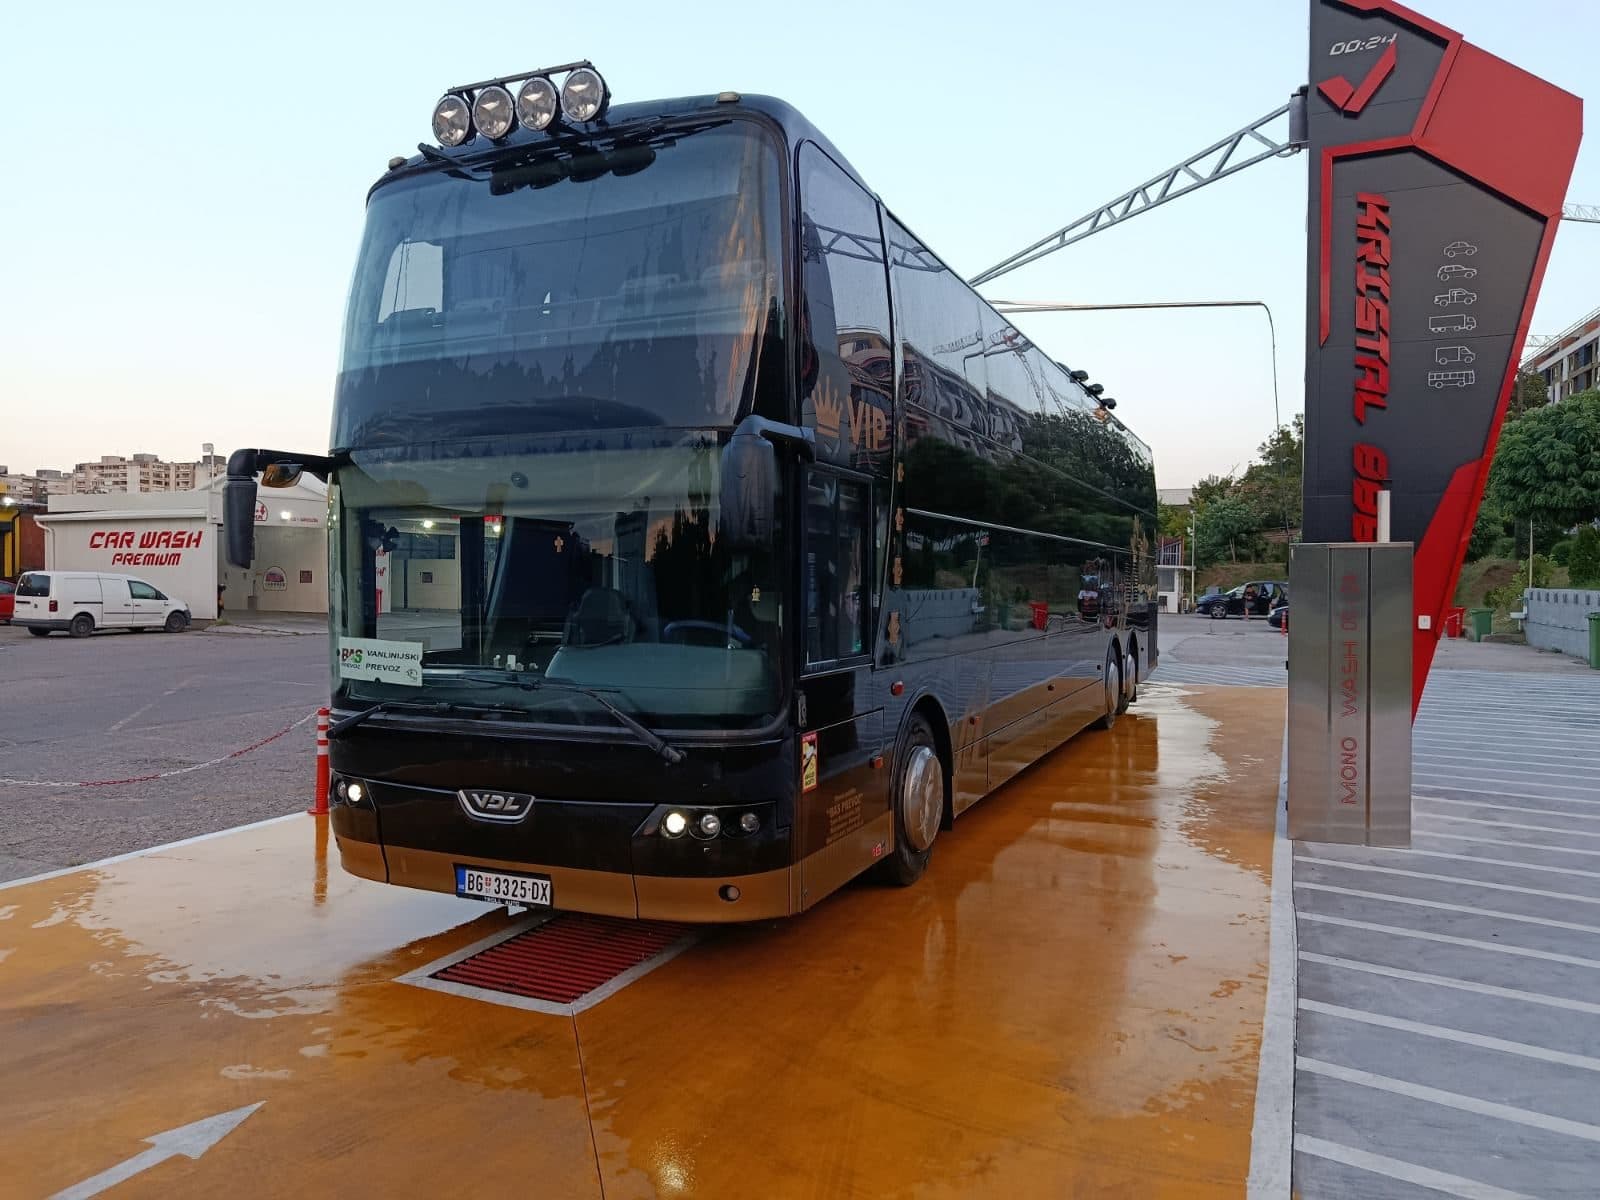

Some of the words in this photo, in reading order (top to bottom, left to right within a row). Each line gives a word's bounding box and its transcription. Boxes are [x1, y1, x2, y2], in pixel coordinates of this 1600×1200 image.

[1329, 32, 1398, 56] 00:24
[1355, 192, 1392, 424] KRISTAL
[847, 394, 887, 449] VIP
[89, 531, 136, 549] CAR
[139, 530, 203, 549] WASH
[111, 552, 182, 566] PREMIUM
[341, 648, 363, 664] BAS
[367, 649, 420, 662] VANLINIJSKI
[365, 663, 402, 673] PREVOZ
[1340, 640, 1361, 716] WASH
[1341, 736, 1358, 805] MONO
[472, 793, 520, 811] VDL
[467, 873, 484, 892] BG
